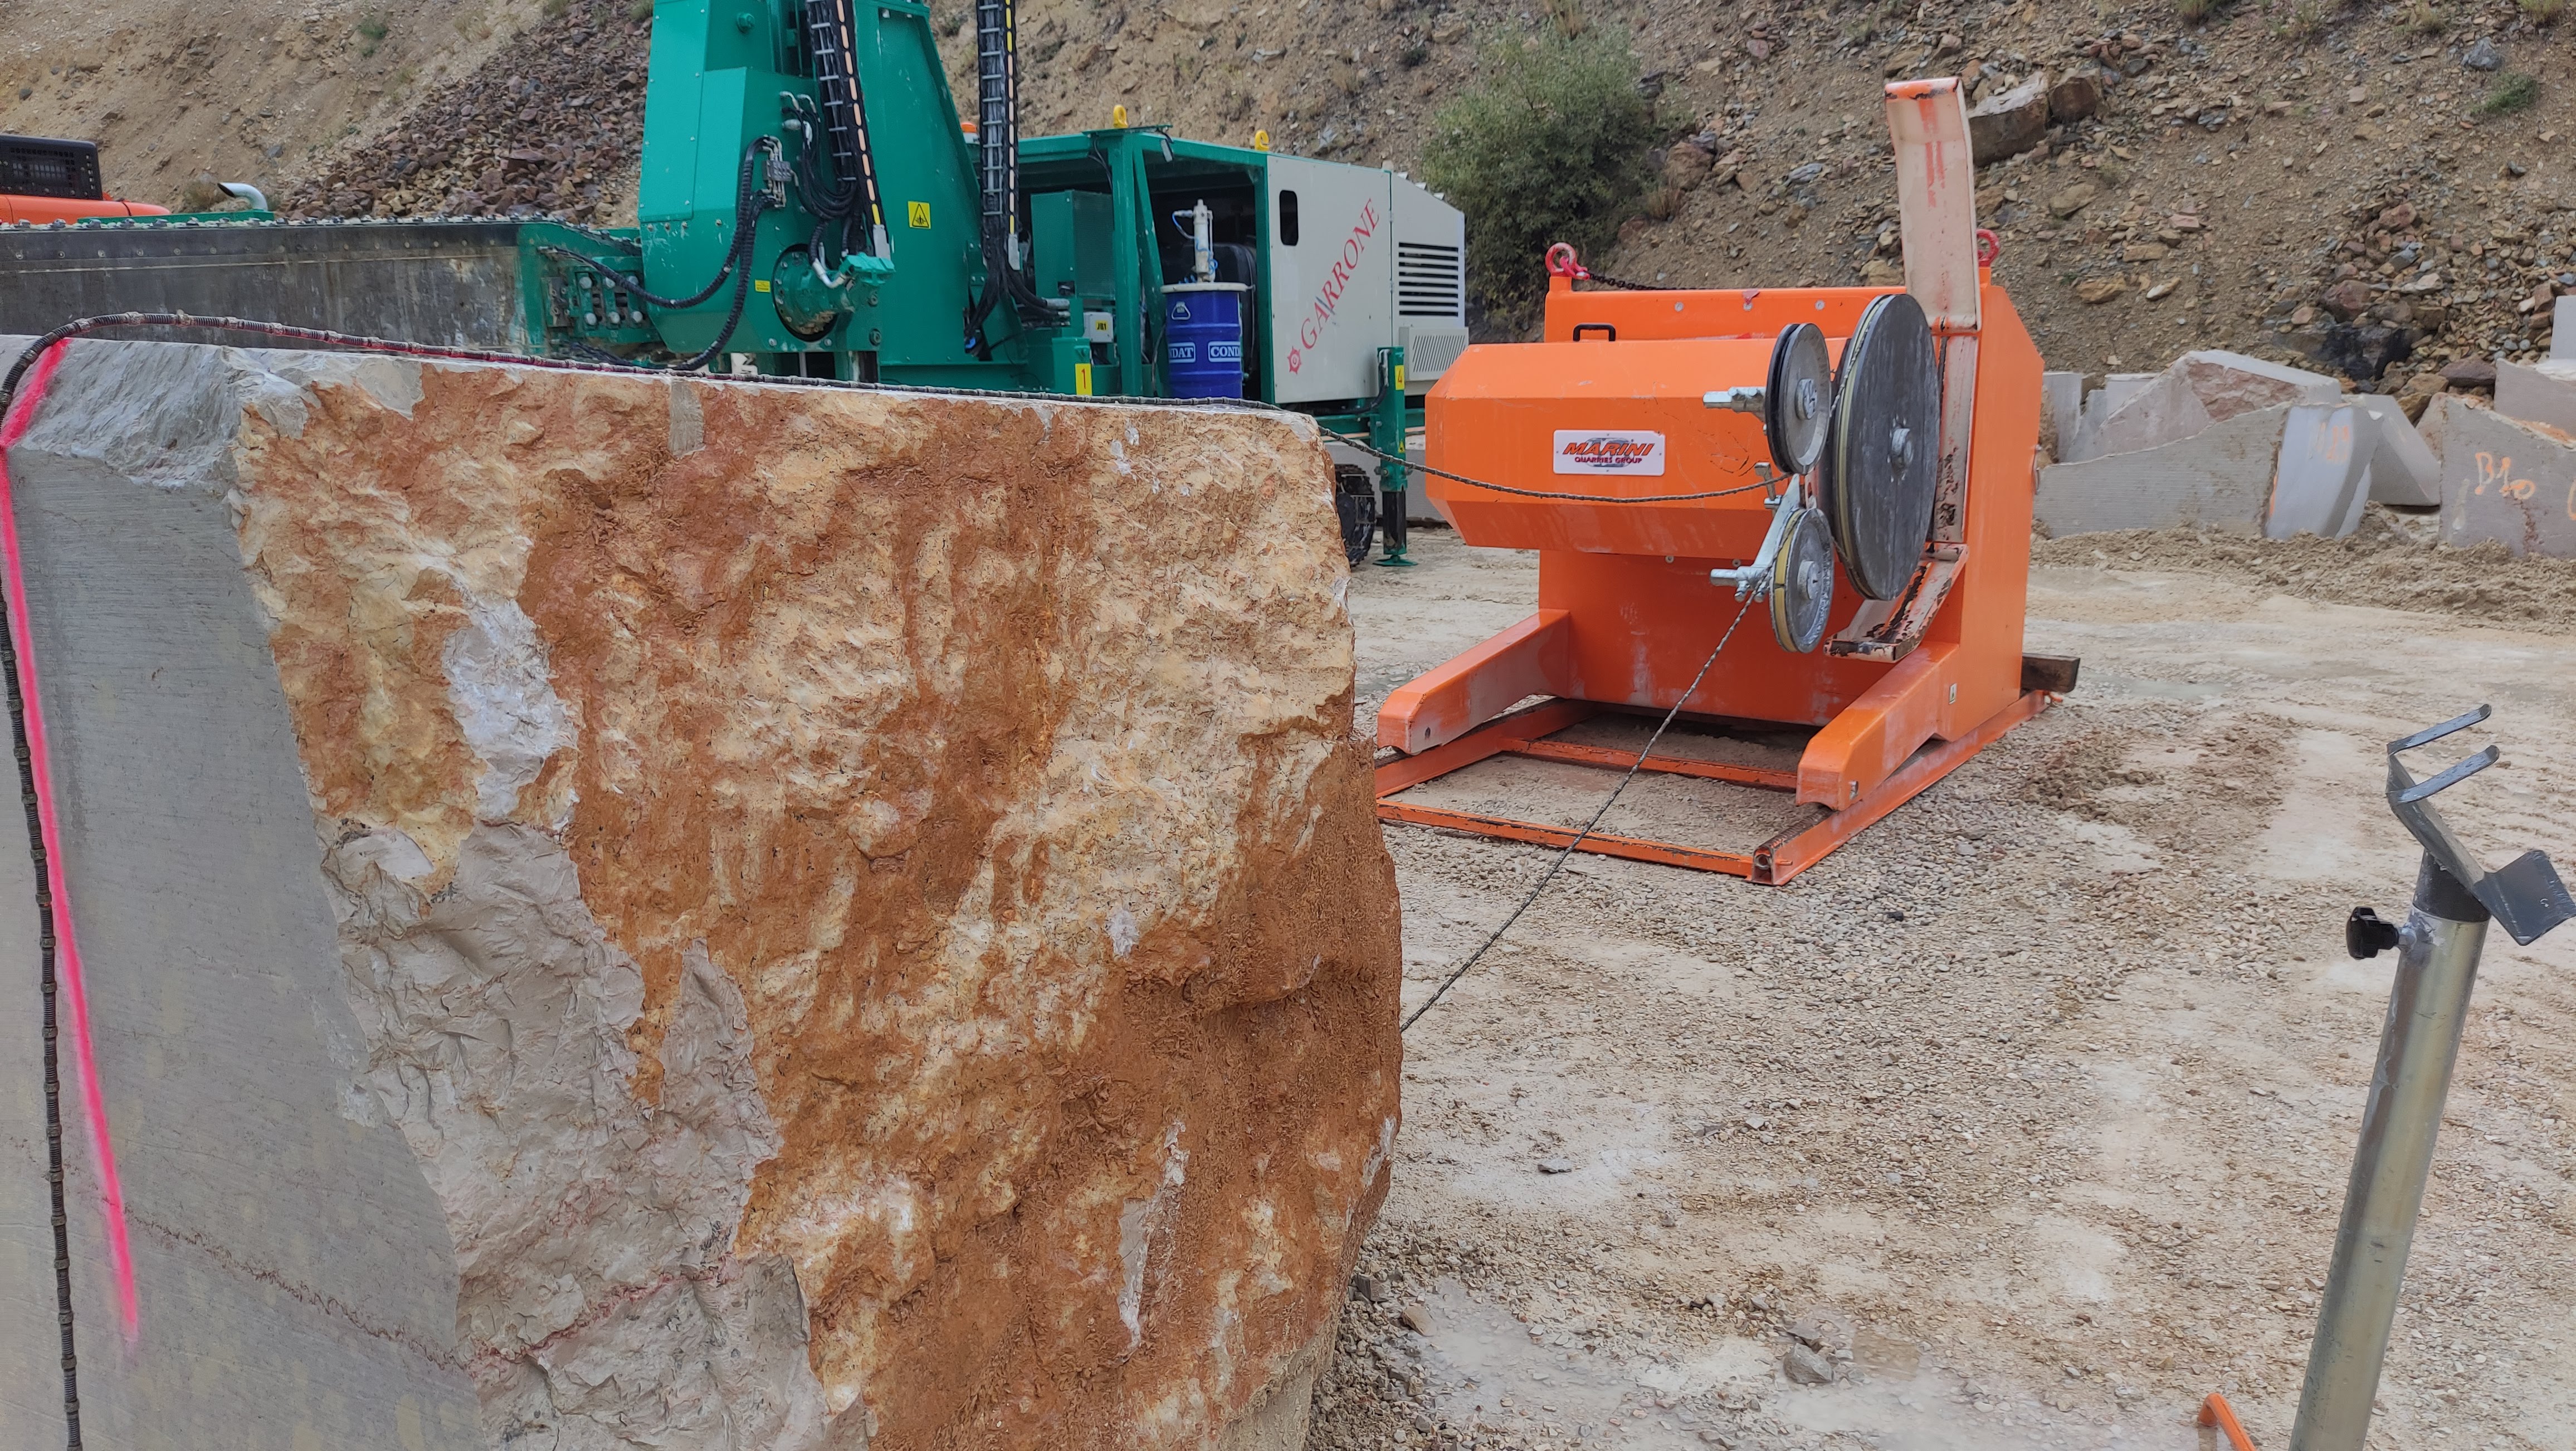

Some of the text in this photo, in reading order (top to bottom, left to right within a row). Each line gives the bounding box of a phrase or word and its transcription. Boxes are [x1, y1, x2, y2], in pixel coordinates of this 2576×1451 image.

[1301, 198, 1379, 349] GARRONE
[1081, 368, 1086, 389] 1
[1397, 369, 1403, 383] 4
[1563, 442, 1655, 456] MARINI
